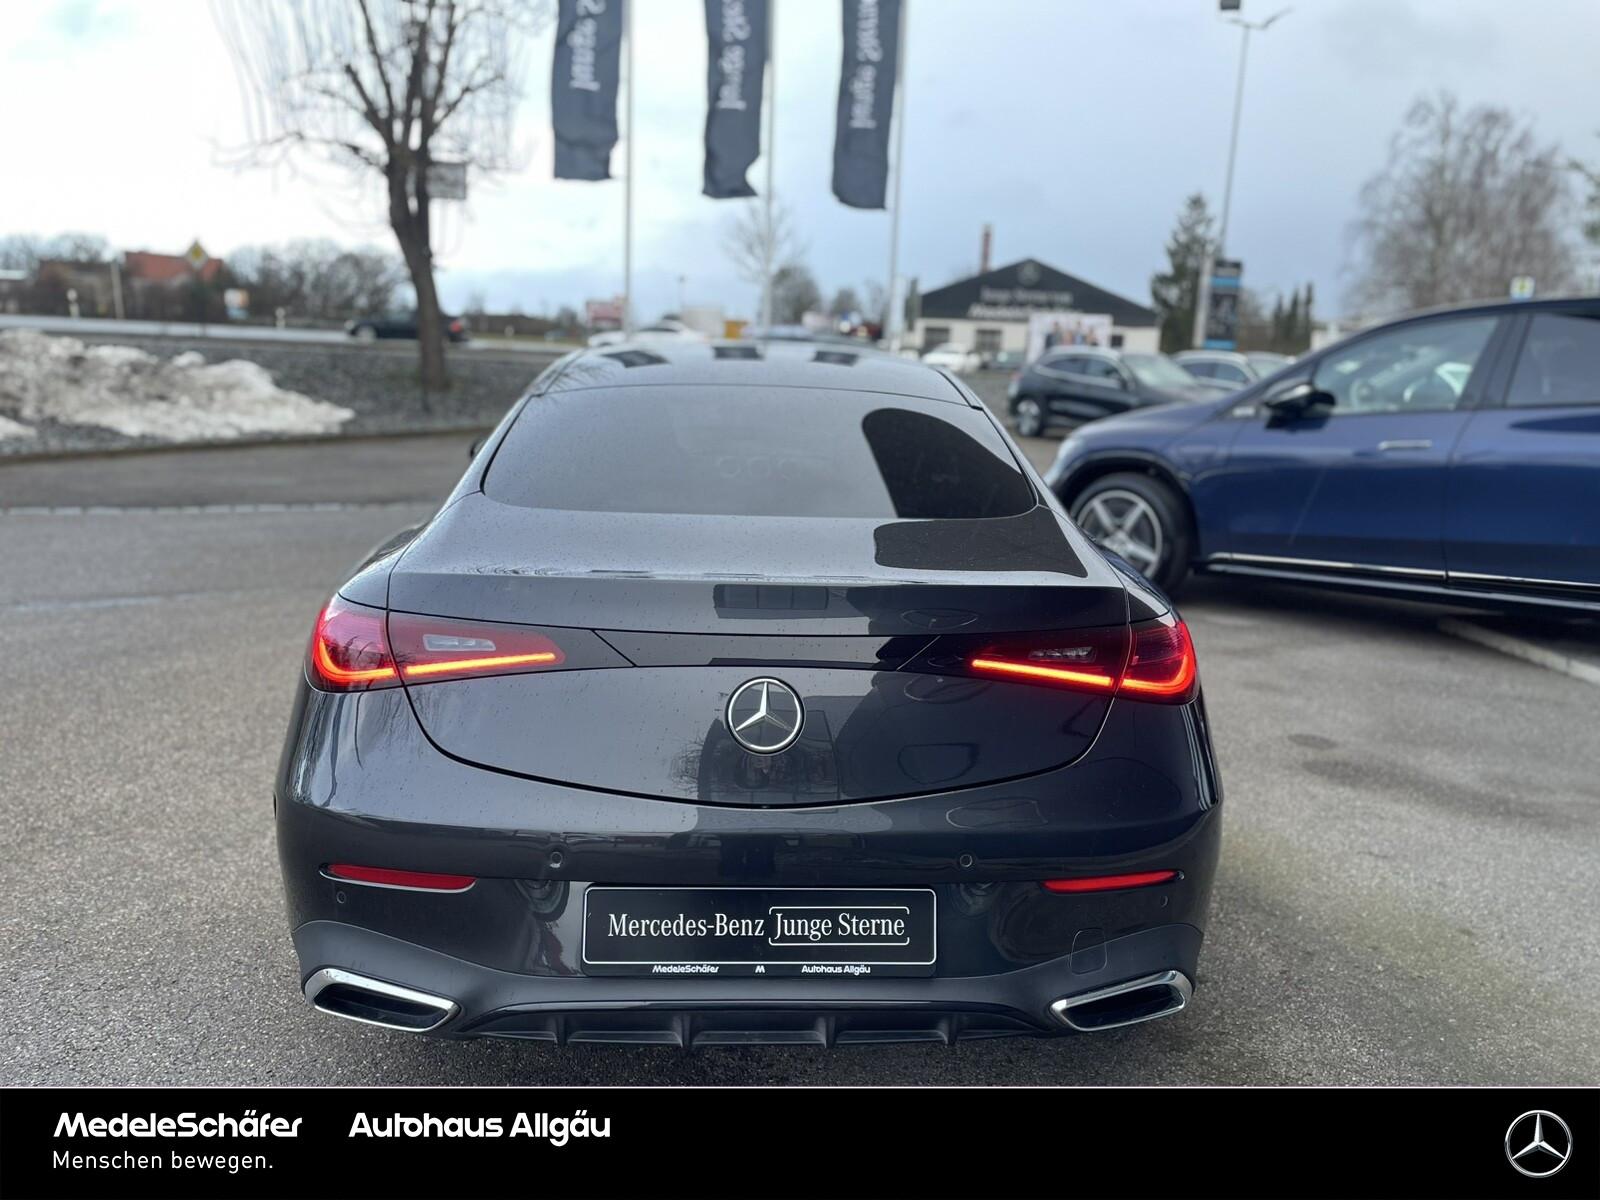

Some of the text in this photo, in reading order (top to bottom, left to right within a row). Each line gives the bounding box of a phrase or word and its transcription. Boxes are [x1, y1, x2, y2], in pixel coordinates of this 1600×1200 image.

[607, 912, 906, 941] Mercedes-Benz Junge Sterne
[652, 964, 720, 974] MedeleSchäfer
[801, 964, 871, 976] Autohaus Allgäu
